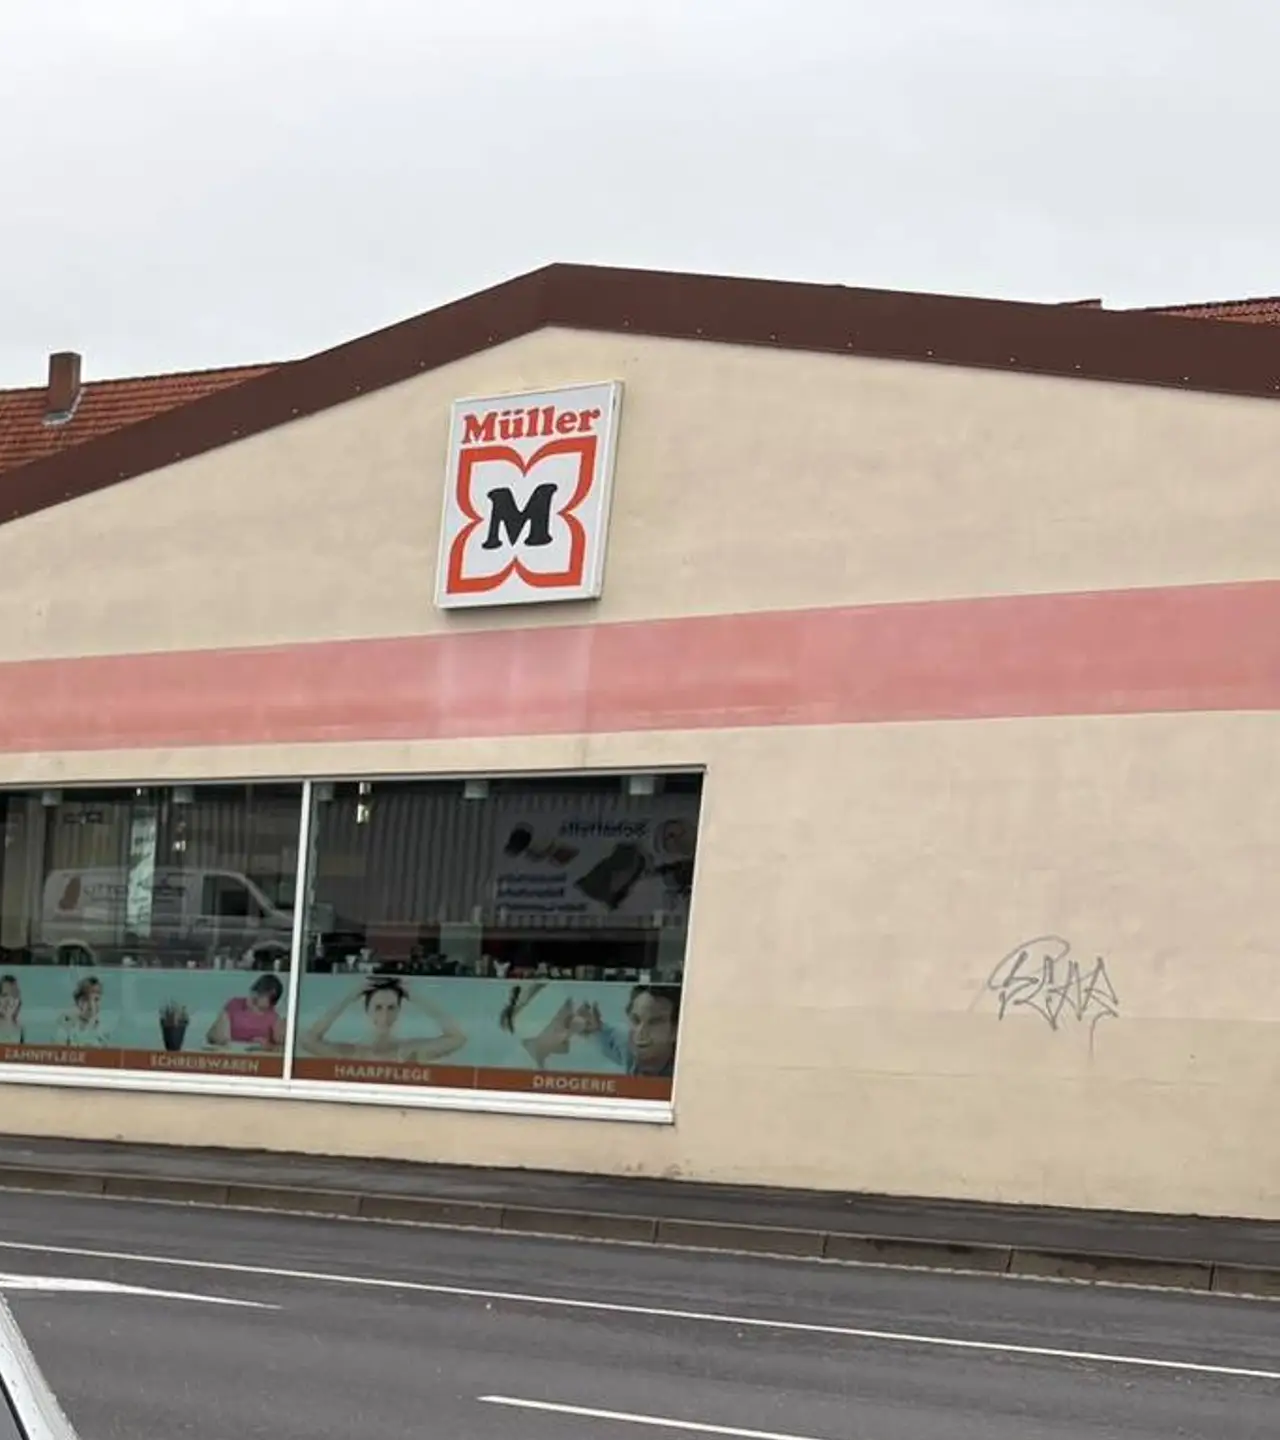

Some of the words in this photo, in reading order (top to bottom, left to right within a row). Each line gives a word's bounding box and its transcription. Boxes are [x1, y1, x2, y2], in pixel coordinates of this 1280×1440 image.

[461, 405, 600, 444] Müller
[481, 484, 558, 549] M
[149, 1052, 260, 1073] SCHREIBWAREN
[334, 1064, 432, 1082] HAARPFLEGE
[533, 1075, 617, 1092] DROGERIE
